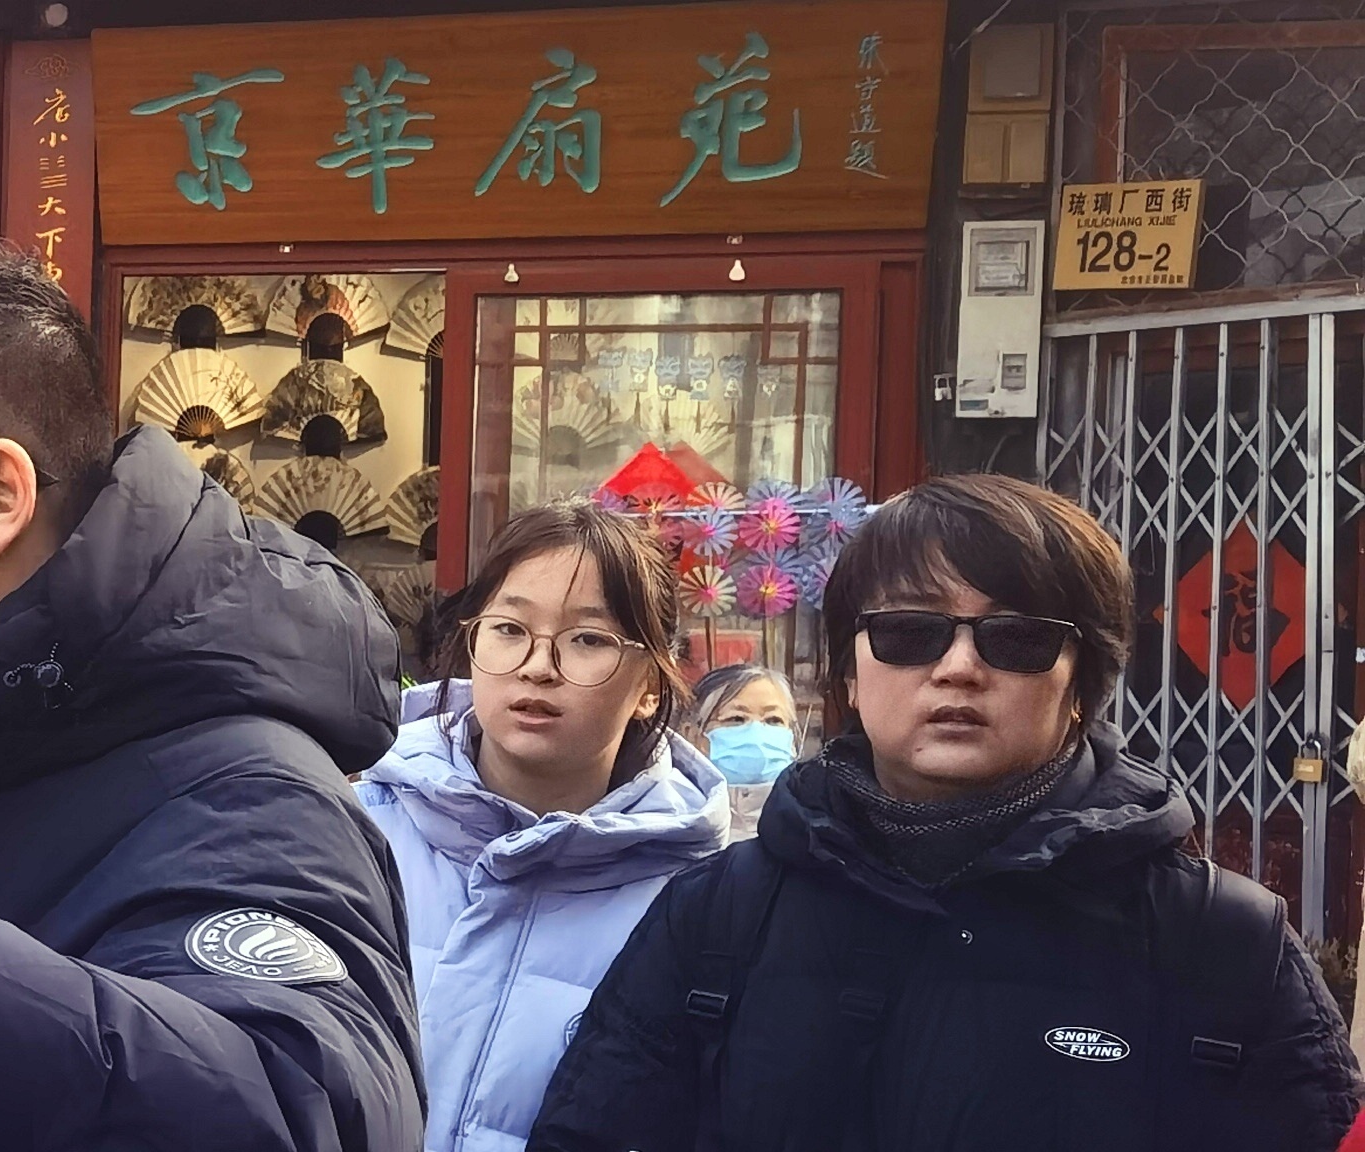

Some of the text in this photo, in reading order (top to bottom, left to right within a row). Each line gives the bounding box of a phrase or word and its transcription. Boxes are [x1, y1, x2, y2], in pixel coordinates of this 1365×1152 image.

[129, 30, 803, 214] 京華扇苑
[1068, 187, 1192, 216] 琉璃厂西街
[1077, 217, 1143, 229] LIULICHANG
[1077, 230, 1171, 273] 128-2
[1054, 1031, 1101, 1042] SNOW
[1070, 1045, 1122, 1057] FLYING
